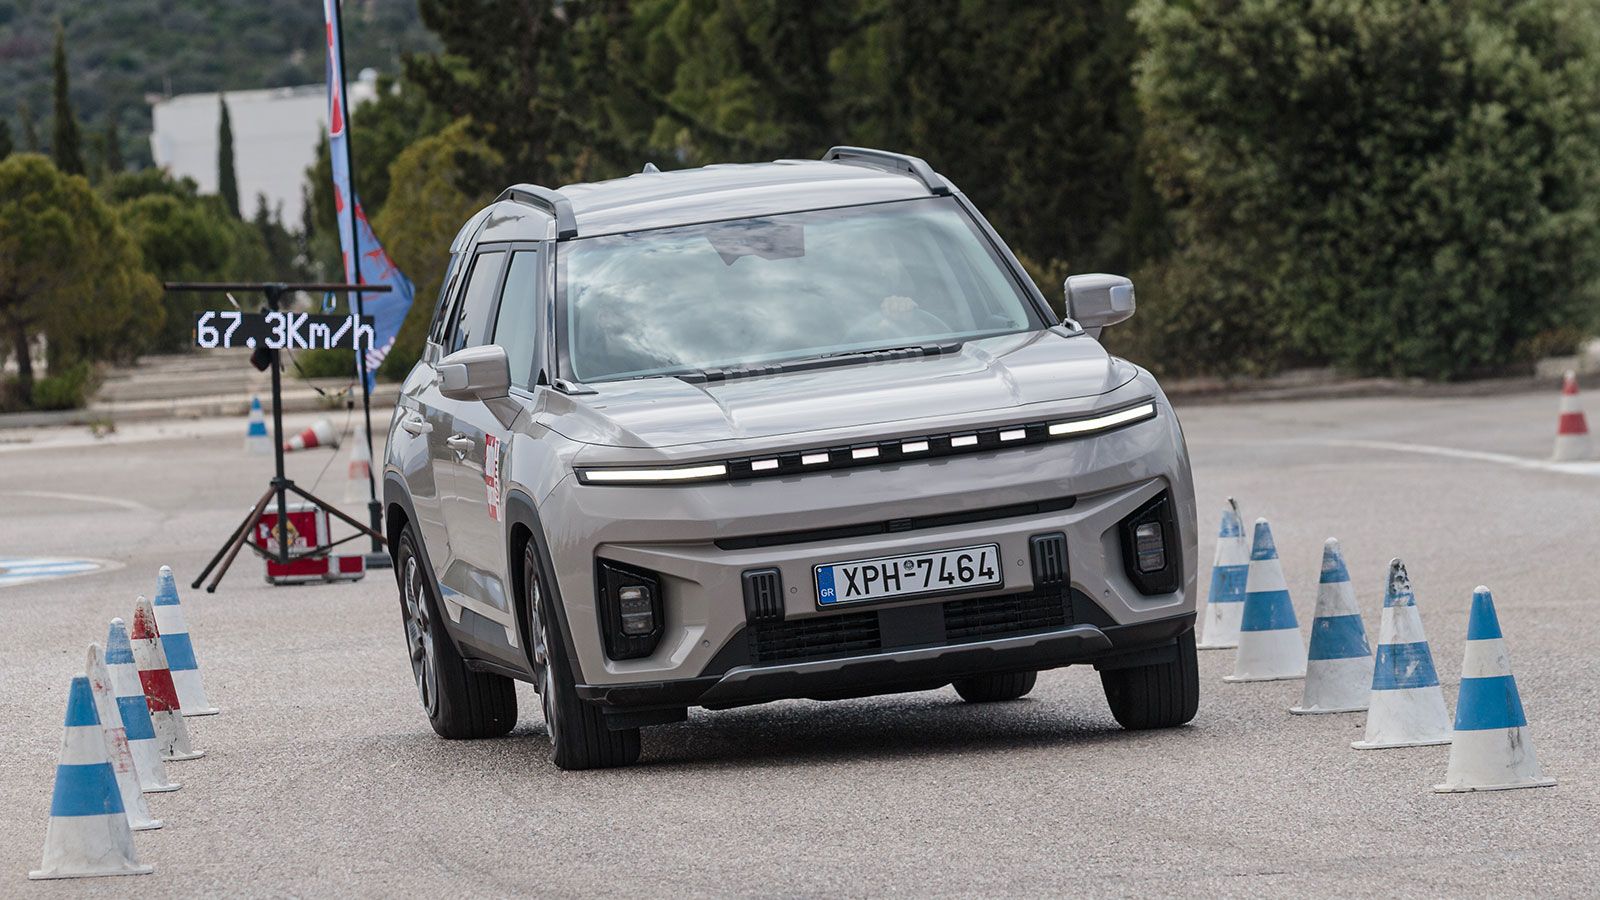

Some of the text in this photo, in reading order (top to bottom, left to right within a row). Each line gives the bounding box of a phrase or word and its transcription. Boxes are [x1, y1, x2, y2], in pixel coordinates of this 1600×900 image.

[197, 311, 374, 350] 67.3Km/h
[820, 588, 834, 598] GR
[842, 551, 994, 597] XPH-7464
